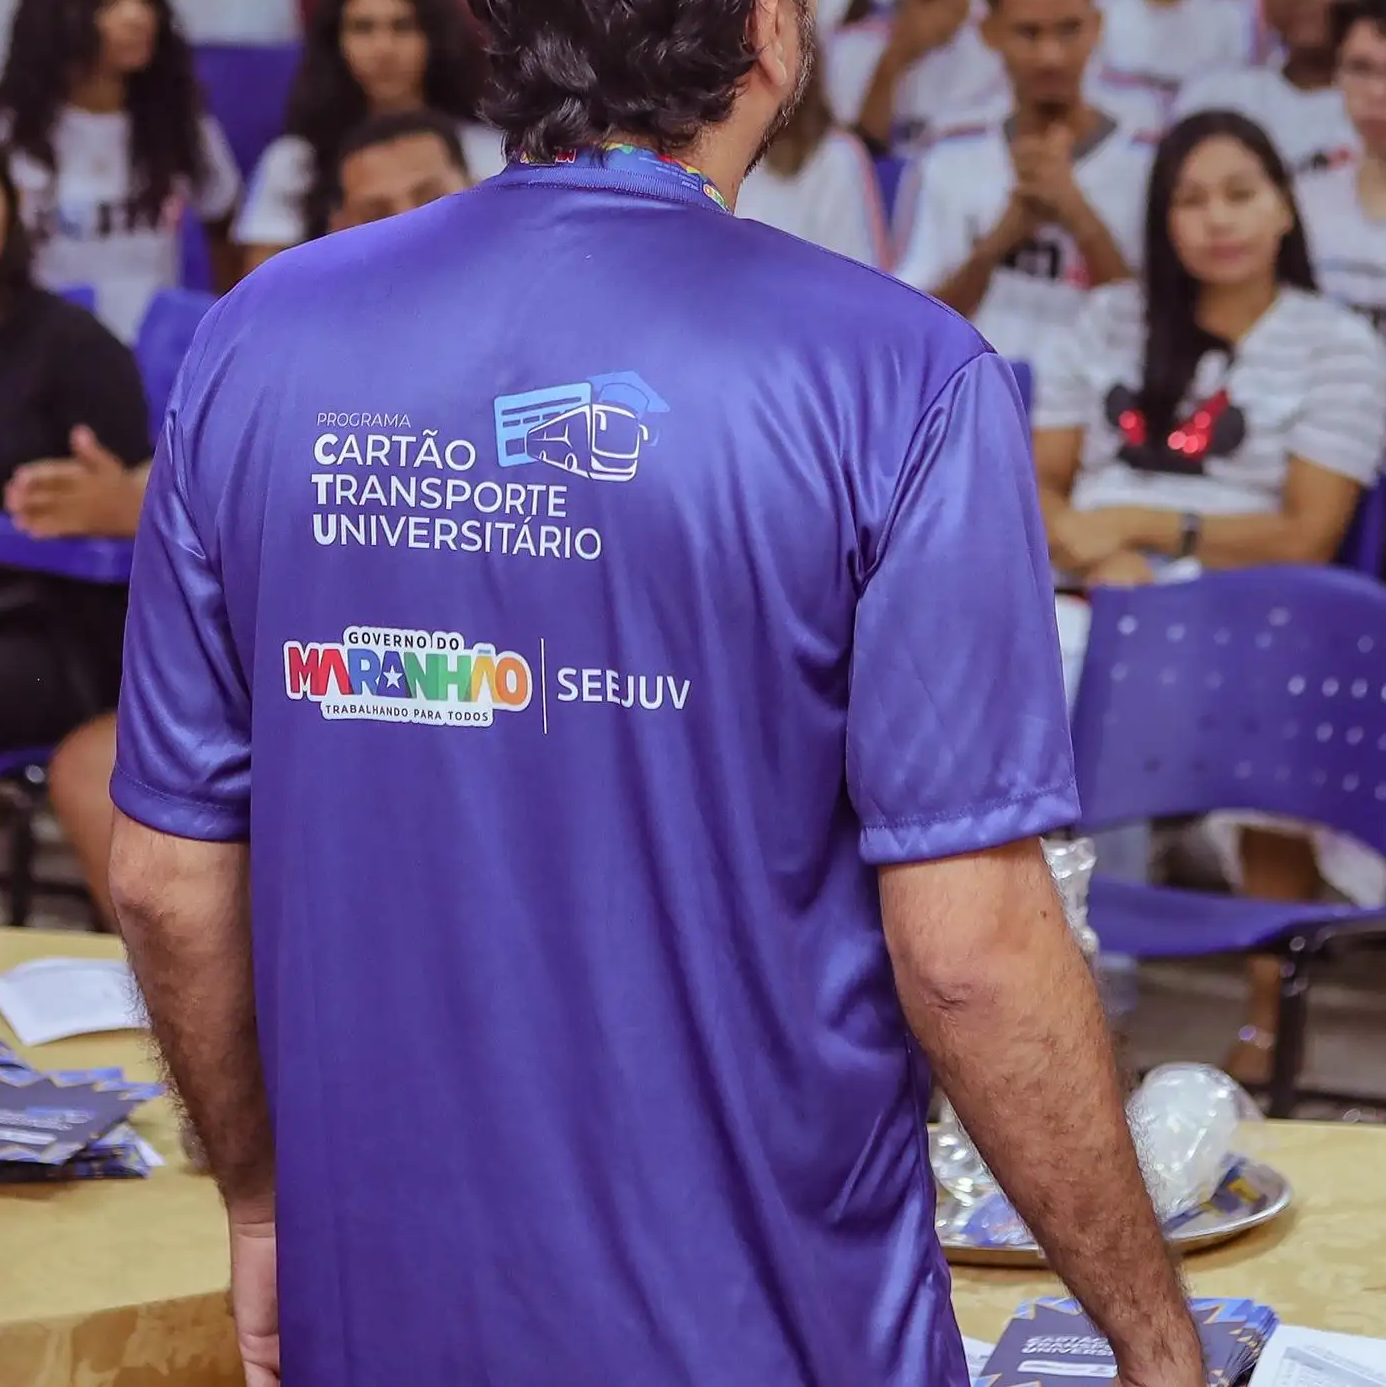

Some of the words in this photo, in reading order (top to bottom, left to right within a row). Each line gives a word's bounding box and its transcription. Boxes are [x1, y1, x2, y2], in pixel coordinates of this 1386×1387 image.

[316, 412, 412, 429] PROGRAMA
[313, 429, 477, 472] CARTÃO
[311, 473, 568, 518] TRANSPORTE
[312, 513, 603, 561] UNIVERSITÁRIO
[348, 631, 427, 649] GOVERNO
[436, 636, 460, 650] DO
[287, 646, 528, 705] MARANHÃO
[325, 704, 409, 718] TRABALHANDO
[414, 708, 442, 720] PARA
[448, 711, 489, 722] TODOS
